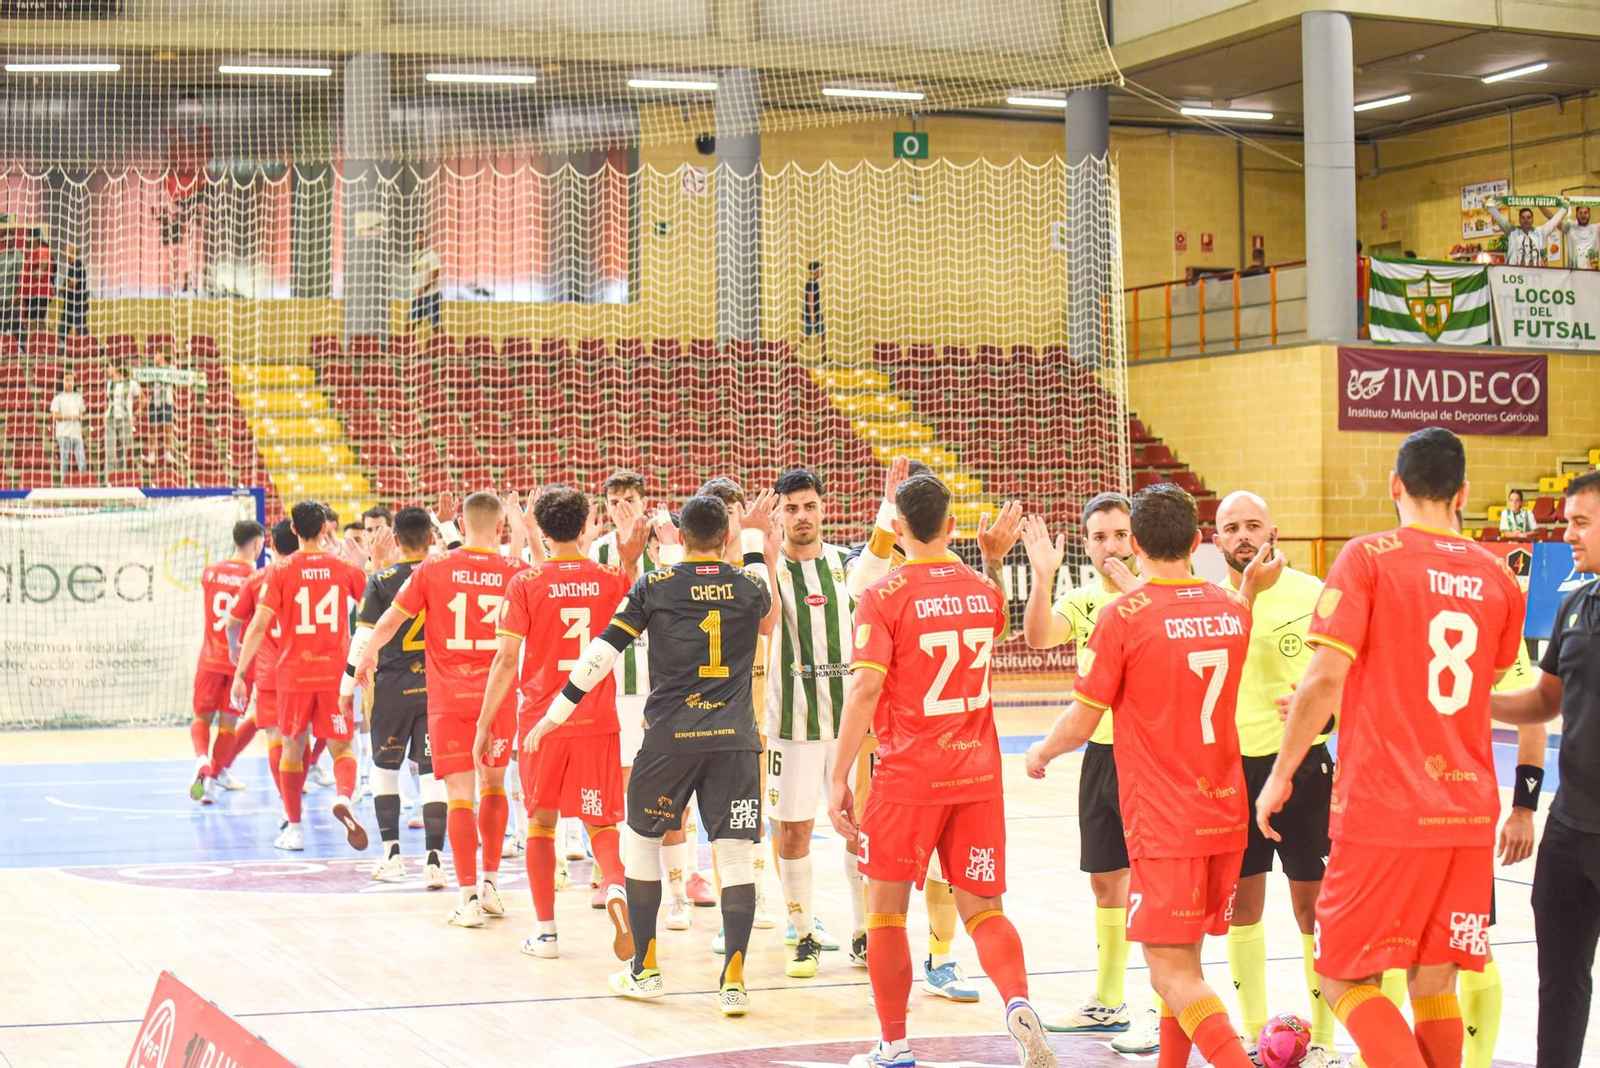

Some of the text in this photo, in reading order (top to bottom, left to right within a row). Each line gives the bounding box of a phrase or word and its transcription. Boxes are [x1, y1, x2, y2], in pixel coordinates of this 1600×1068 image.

[1503, 274, 1524, 284] LOS
[1515, 288, 1576, 306] LOCOS
[1530, 306, 1552, 317] DEL
[1513, 319, 1596, 340] FUTSAL
[1394, 368, 1541, 406] IMDECO
[1348, 406, 1540, 424] Instituto Municipal de Deportes Córdoba
[301, 568, 331, 580] MOTTA
[452, 569, 503, 587] MELLADO
[1426, 568, 1484, 601] TOMAZ
[548, 581, 600, 599] JUNINHO
[690, 583, 735, 601] CHEMI
[294, 584, 340, 635] 14
[914, 594, 994, 619] DARÍO GIL
[446, 591, 506, 651] 13
[1164, 612, 1243, 639] CASTEJÓN
[557, 607, 591, 672] 3
[699, 609, 730, 678] 1
[919, 626, 995, 717] 23
[1427, 609, 1479, 716] 8
[1187, 648, 1229, 745] 7
[674, 731, 696, 739] SEMPER
[767, 749, 782, 777] 16
[931, 779, 956, 788] SEMPER
[1444, 769, 1478, 782] ribea
[1418, 817, 1446, 826] SEMPER
[1126, 892, 1143, 929] 7
